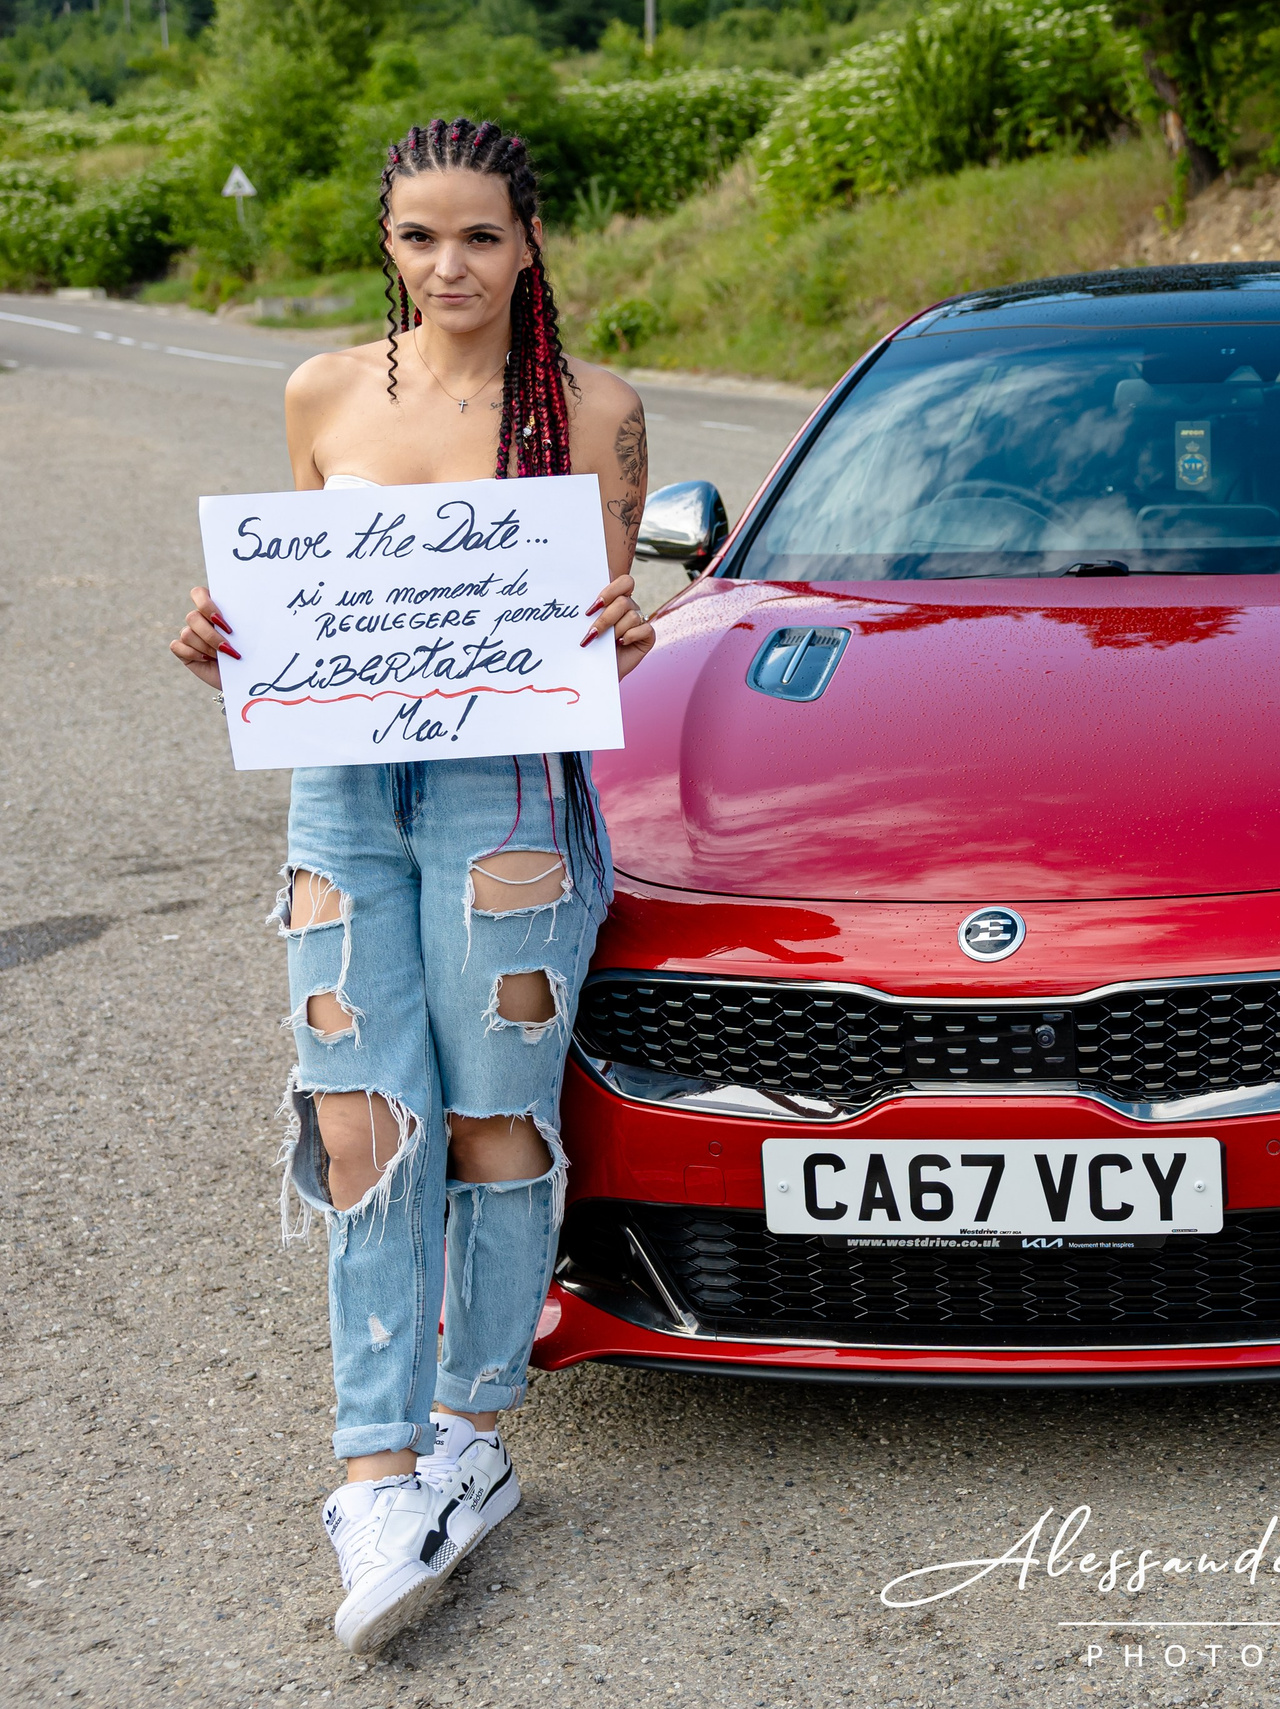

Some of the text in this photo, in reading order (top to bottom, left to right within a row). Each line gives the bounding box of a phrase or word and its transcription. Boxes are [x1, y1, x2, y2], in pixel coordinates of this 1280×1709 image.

[1184, 462, 1202, 470] VIP
[233, 500, 548, 561] Save the Date...
[335, 588, 374, 607] un
[385, 573, 503, 605] moment
[496, 569, 529, 597] de
[315, 598, 579, 641] RECULEGERE pentru
[373, 695, 478, 744] Mea!
[802, 1152, 1187, 1222] CA67 VCY
[847, 1237, 1000, 1248] www.westdrive.co.uk
[1022, 1238, 1064, 1249] KIA
[471, 1486, 485, 1511] adidas
[330, 1515, 343, 1536] adidas
